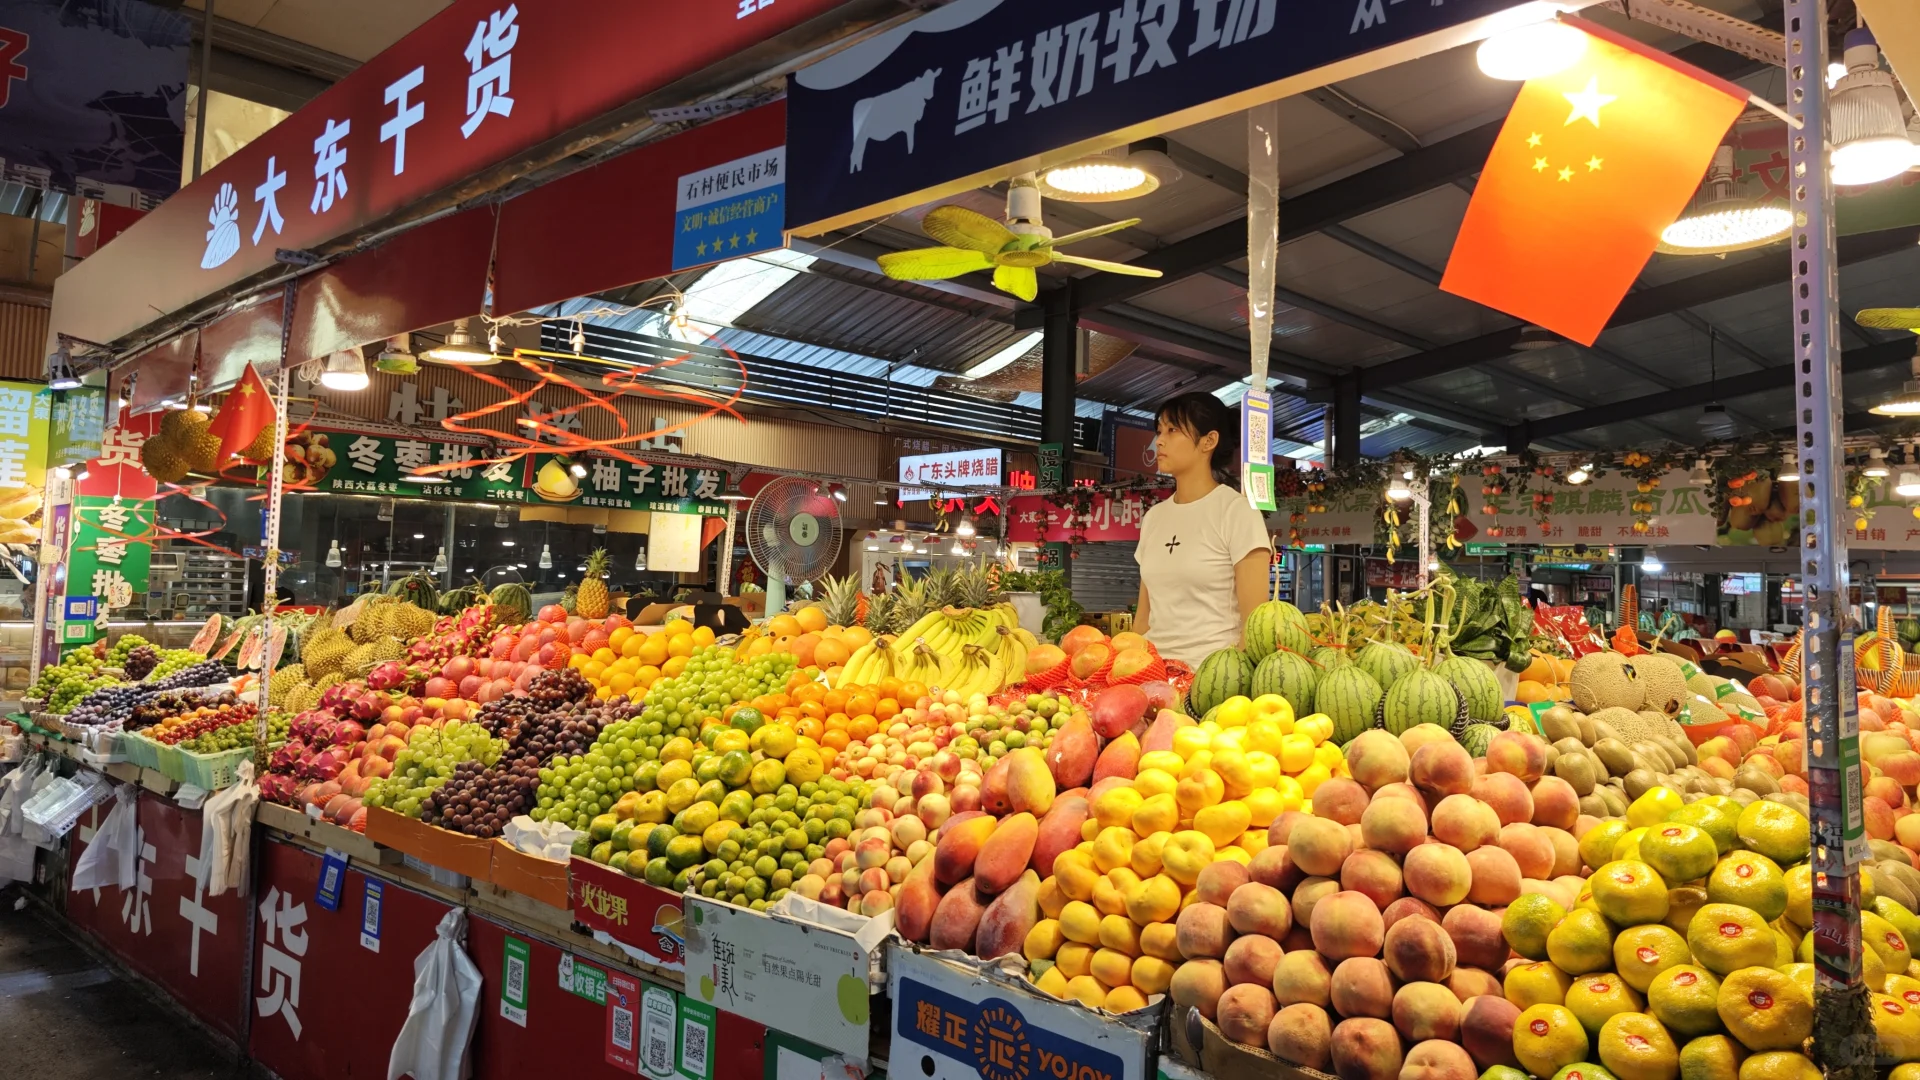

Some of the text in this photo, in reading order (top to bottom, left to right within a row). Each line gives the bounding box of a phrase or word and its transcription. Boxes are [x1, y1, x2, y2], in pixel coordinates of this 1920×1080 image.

[955, 0, 1277, 136] 鲜奶牧场
[251, 3, 519, 246] 大东干货
[686, 157, 779, 201] 石村便民市场
[347, 435, 514, 483] 冬枣批发
[592, 458, 720, 500] 柚子批发
[918, 456, 999, 481] 广东头牌烧腊
[332, 479, 525, 500] 陕西大荔冬枣 沾化冬枣 二代冬枣
[1577, 526, 1602, 538] 脆甜
[581, 881, 629, 926] 火龙果
[575, 973, 606, 1003] 收银台
[916, 1000, 968, 1049] 耀正
